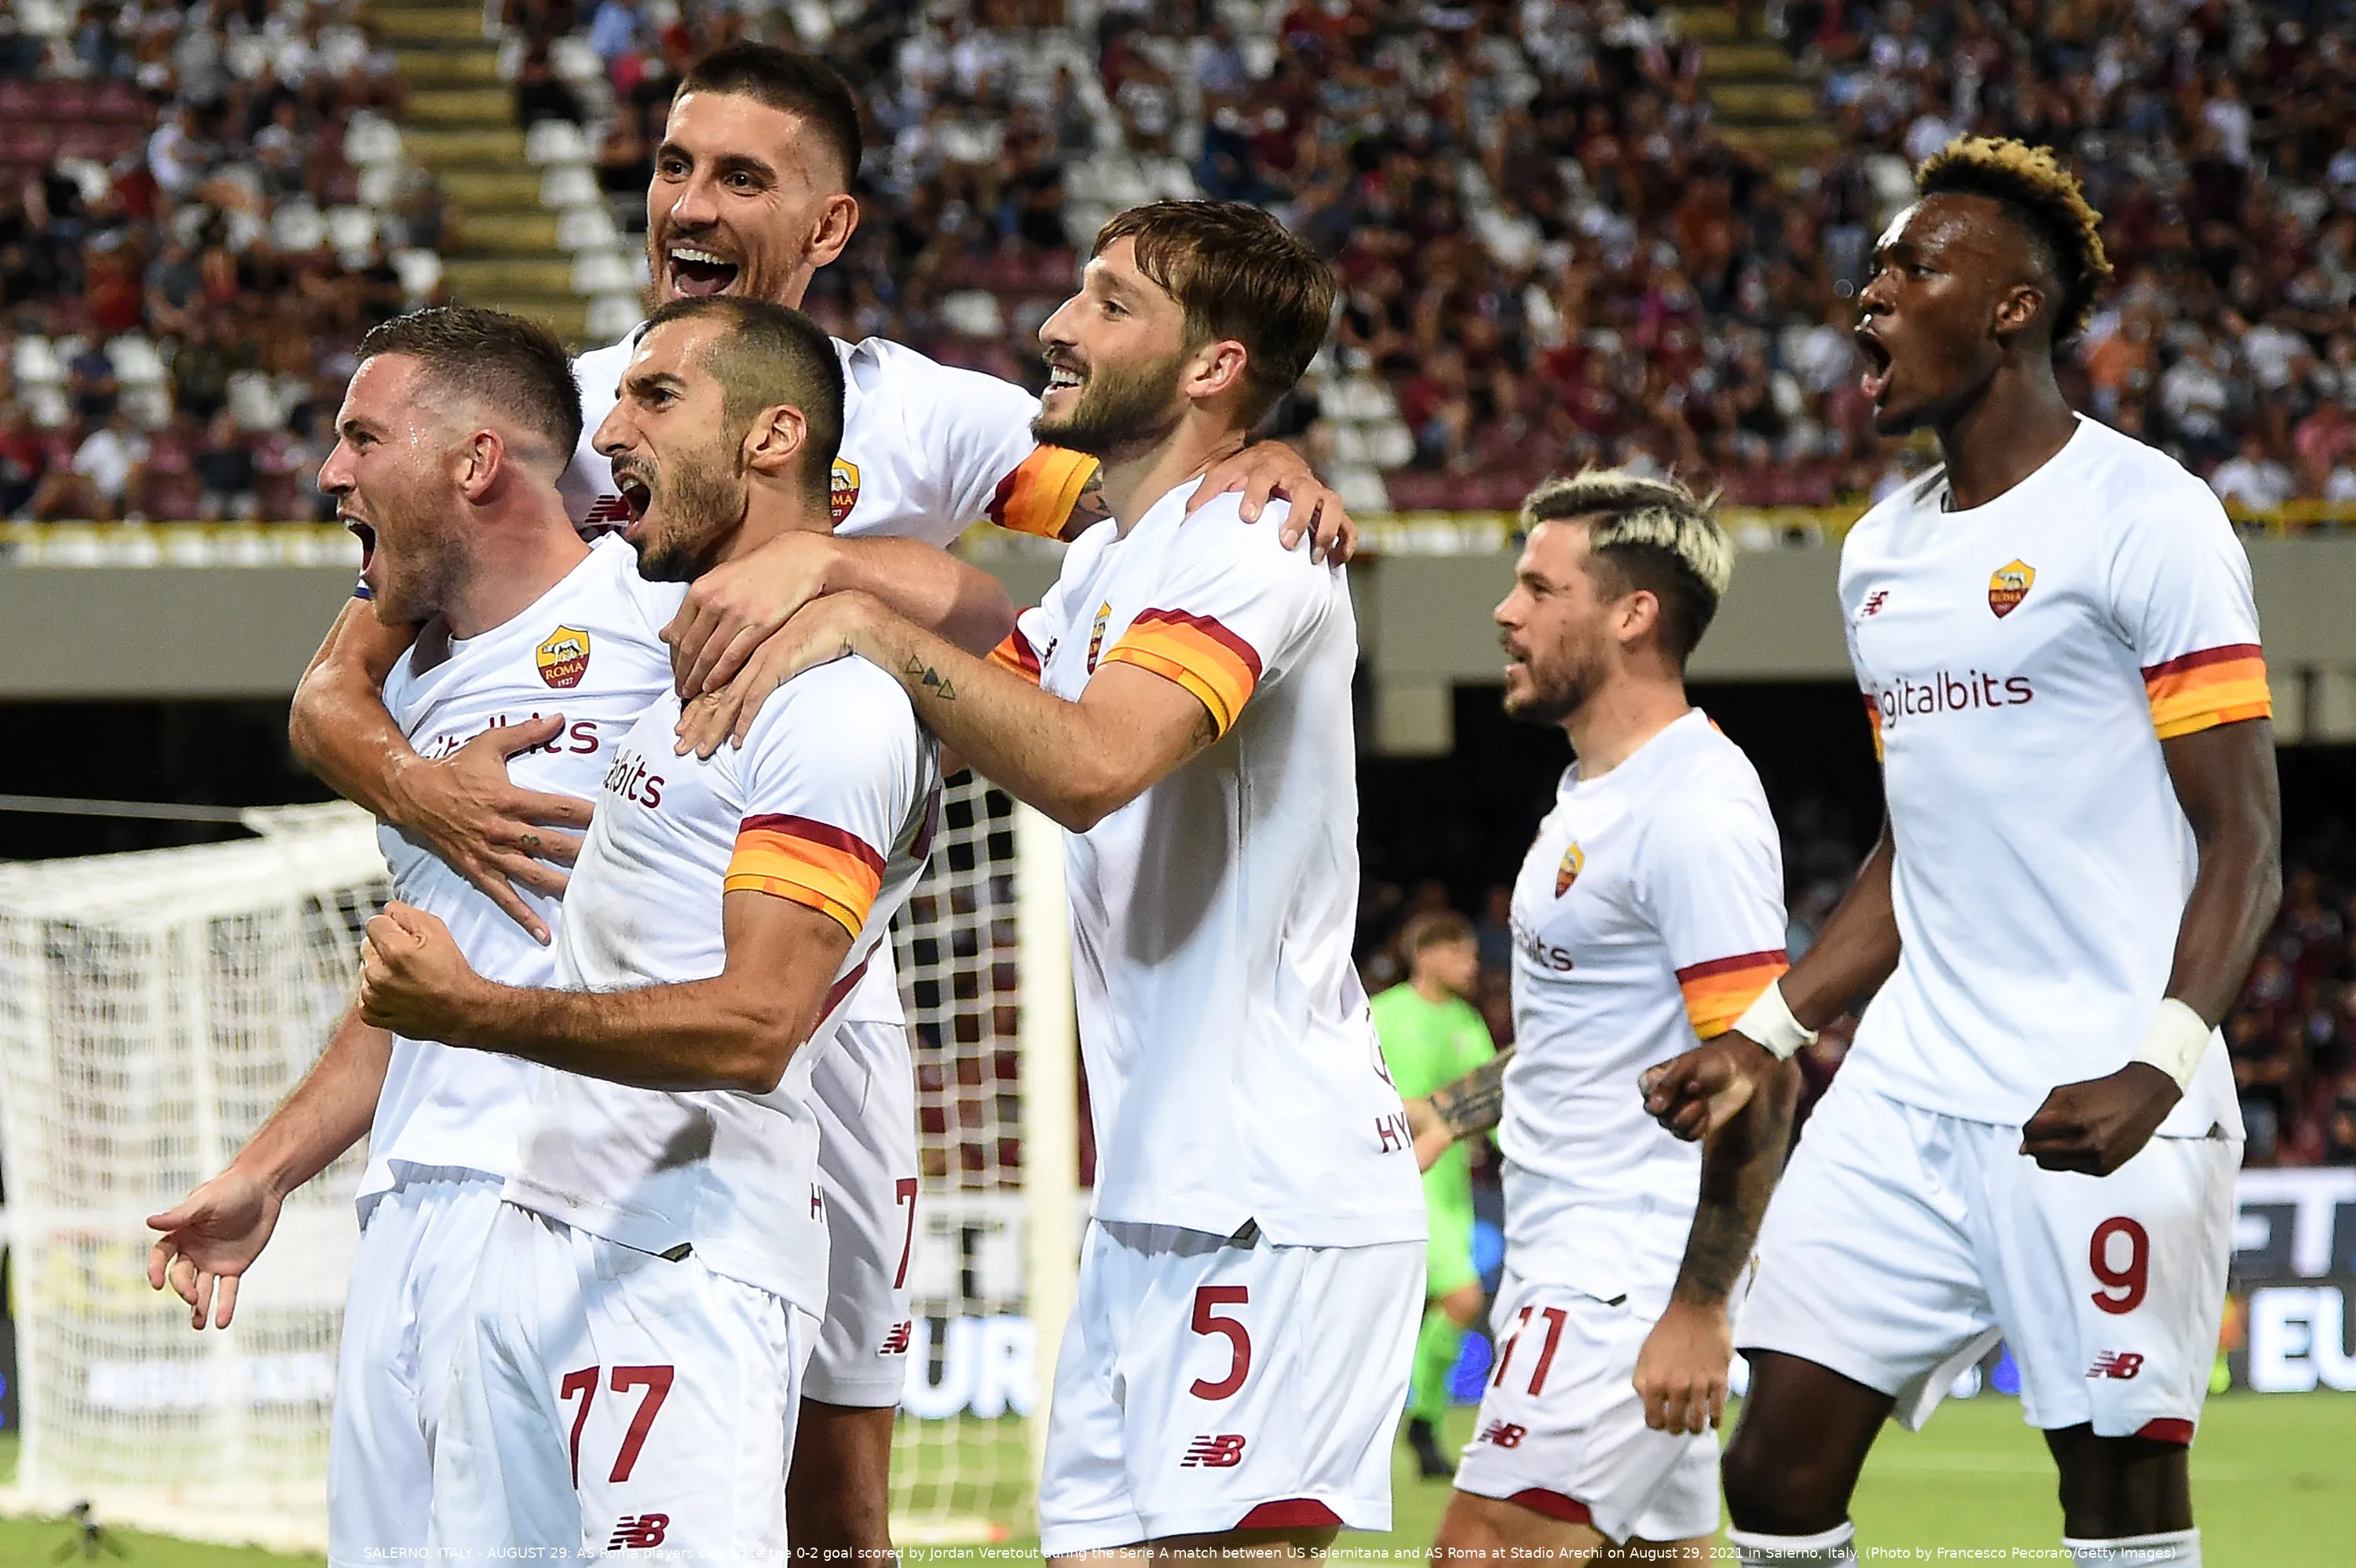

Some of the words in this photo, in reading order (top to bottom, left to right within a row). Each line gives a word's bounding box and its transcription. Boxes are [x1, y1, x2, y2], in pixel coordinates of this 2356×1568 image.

[545, 661, 584, 680] ROMA
[558, 677, 573, 687] 1927
[893, 1177, 917, 1289] 7
[2089, 1215, 2149, 1314] 9
[1189, 1285, 1251, 1401] 5
[1494, 1305, 1568, 1396] 11
[2086, 1350, 2144, 1380] NB
[560, 1365, 674, 1490] 77
[1180, 1435, 1246, 1467] NB
[607, 1512, 670, 1551] NB
